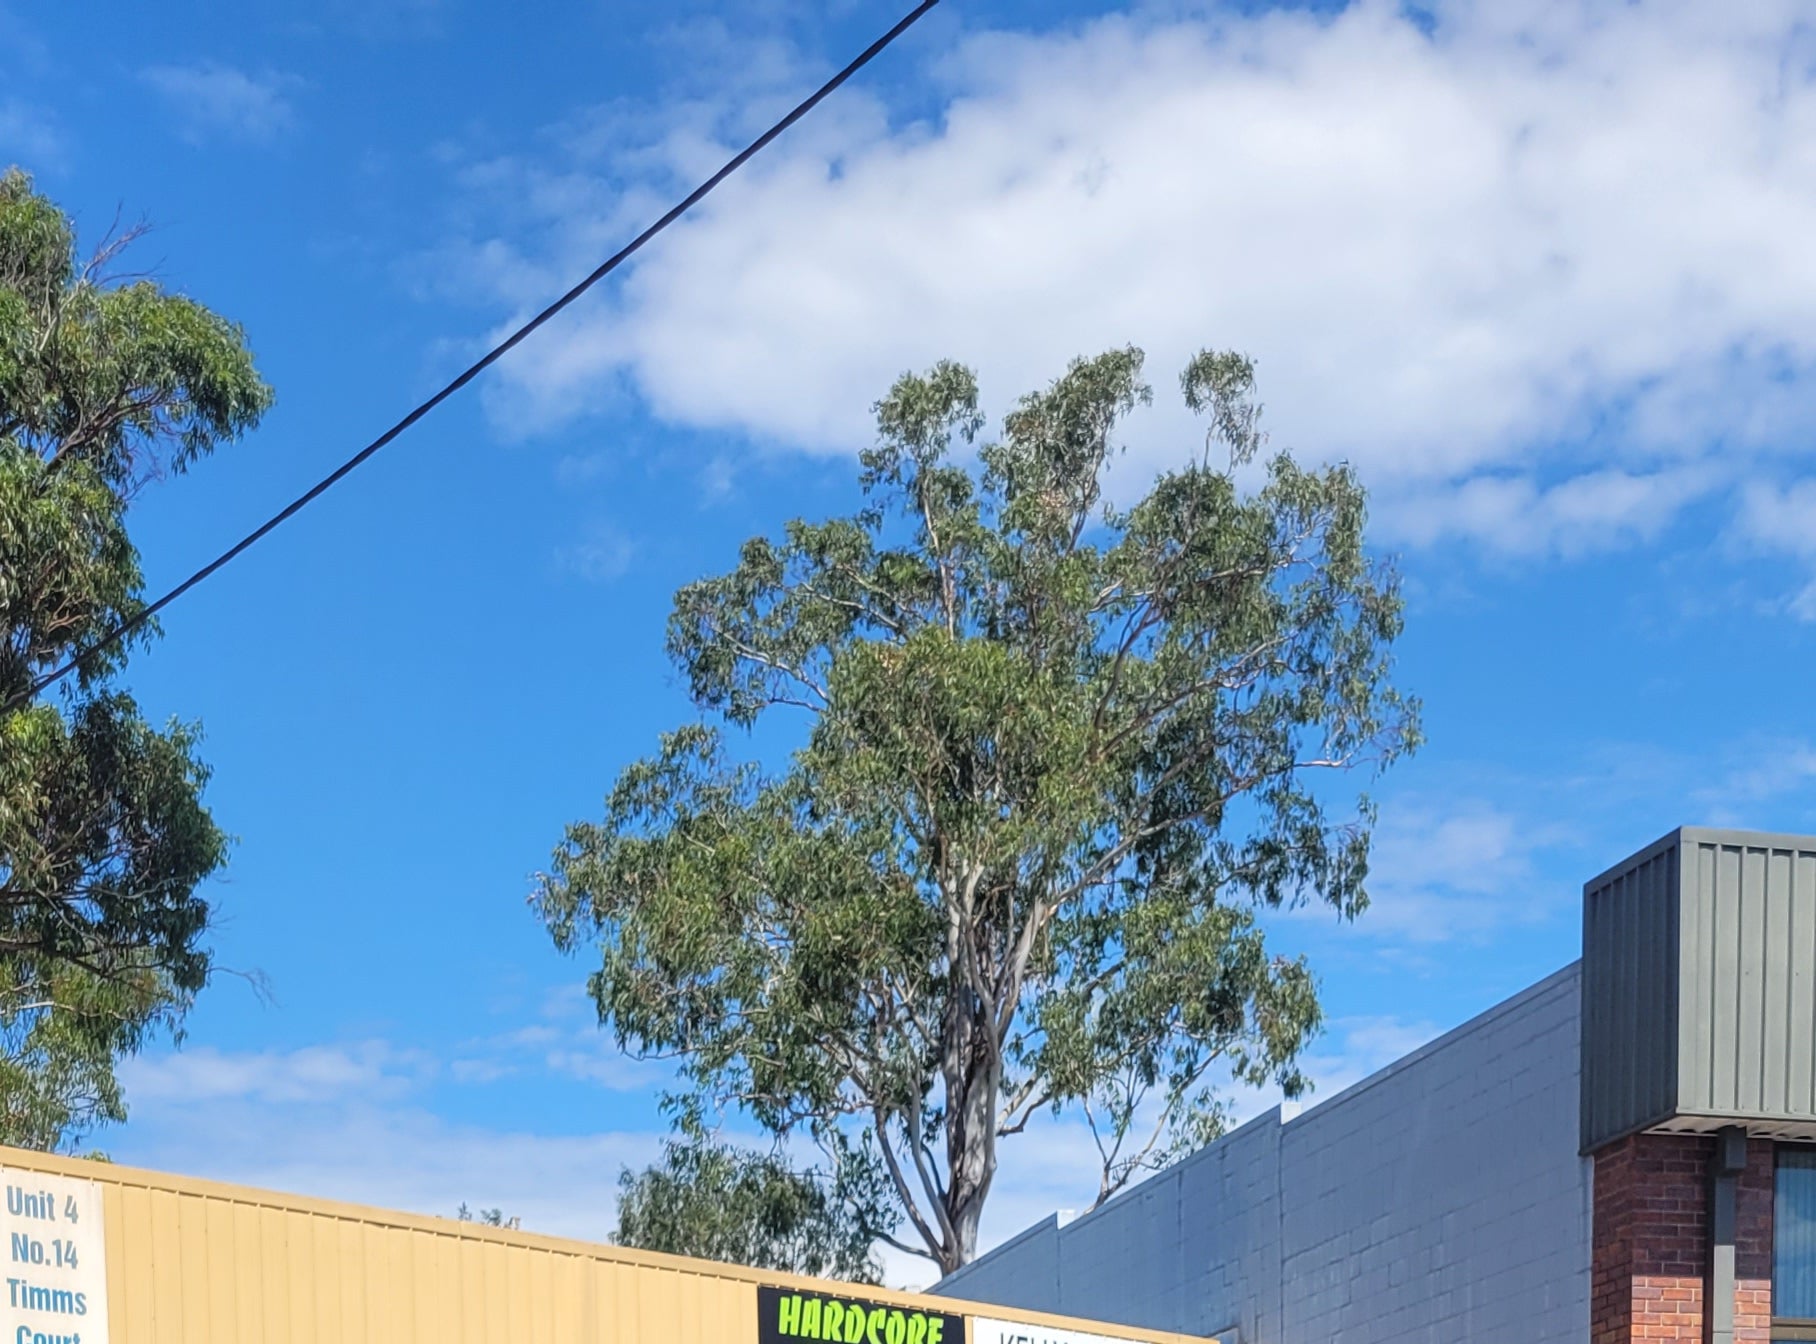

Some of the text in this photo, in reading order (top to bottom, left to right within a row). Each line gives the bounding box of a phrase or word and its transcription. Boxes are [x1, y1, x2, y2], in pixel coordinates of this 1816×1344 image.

[6, 1185, 79, 1224] Unit 4
[11, 1231, 78, 1269] No.14
[6, 1277, 87, 1316] Timms
